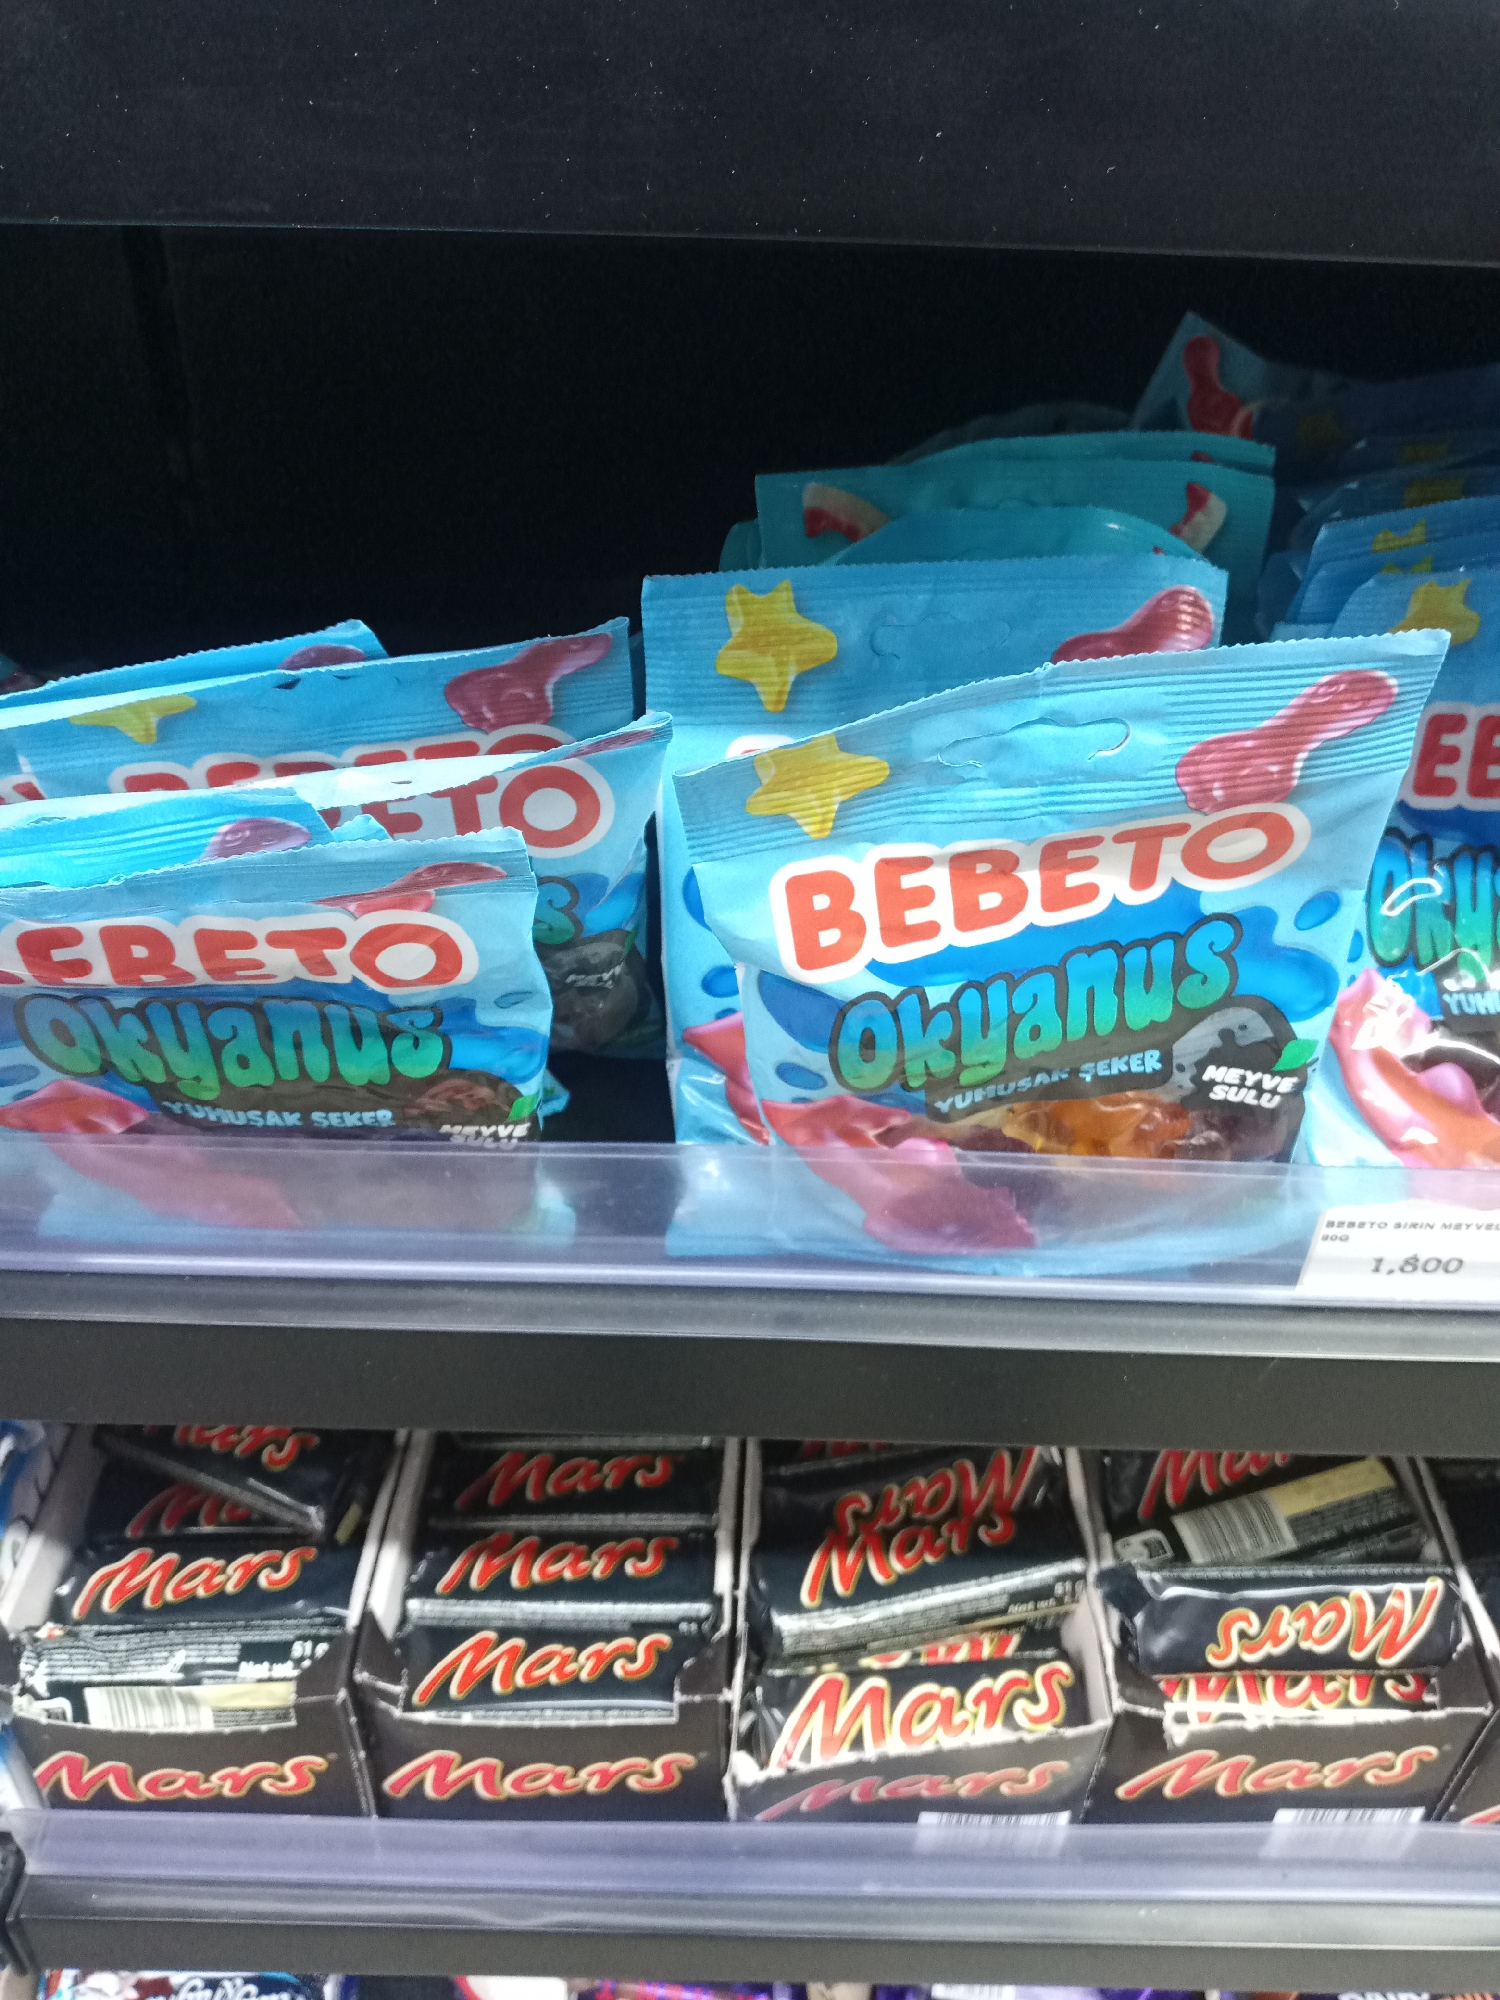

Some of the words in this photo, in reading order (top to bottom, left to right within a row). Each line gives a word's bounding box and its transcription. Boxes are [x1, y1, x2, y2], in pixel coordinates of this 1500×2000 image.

[777, 808, 1303, 977] BEBETO
[0, 922, 466, 989] EBETO
[832, 914, 1238, 1092] Okyanus
[18, 997, 448, 1101] Okyanus
[1077, 1048, 1164, 1084] ŞEKER
[1201, 1064, 1300, 1095] MEYVE
[1208, 1083, 1281, 1110] SULU
[1325, 1219, 1388, 1230] BEBETO
[1441, 1222, 1500, 1231] MEYVEL
[1371, 1253, 1464, 1276] 1,800
[455, 1451, 678, 1511] Mars
[73, 1547, 318, 1621] Mars
[436, 1532, 679, 1595] Mars
[1206, 1577, 1445, 1666] Mars
[412, 1631, 673, 1706] Mars
[768, 1661, 1075, 1772] Mars
[34, 1750, 330, 1802] Mars
[383, 1749, 699, 1800] Mars
[756, 1761, 1072, 1821] Mars
[1116, 1746, 1439, 1799] Mars
